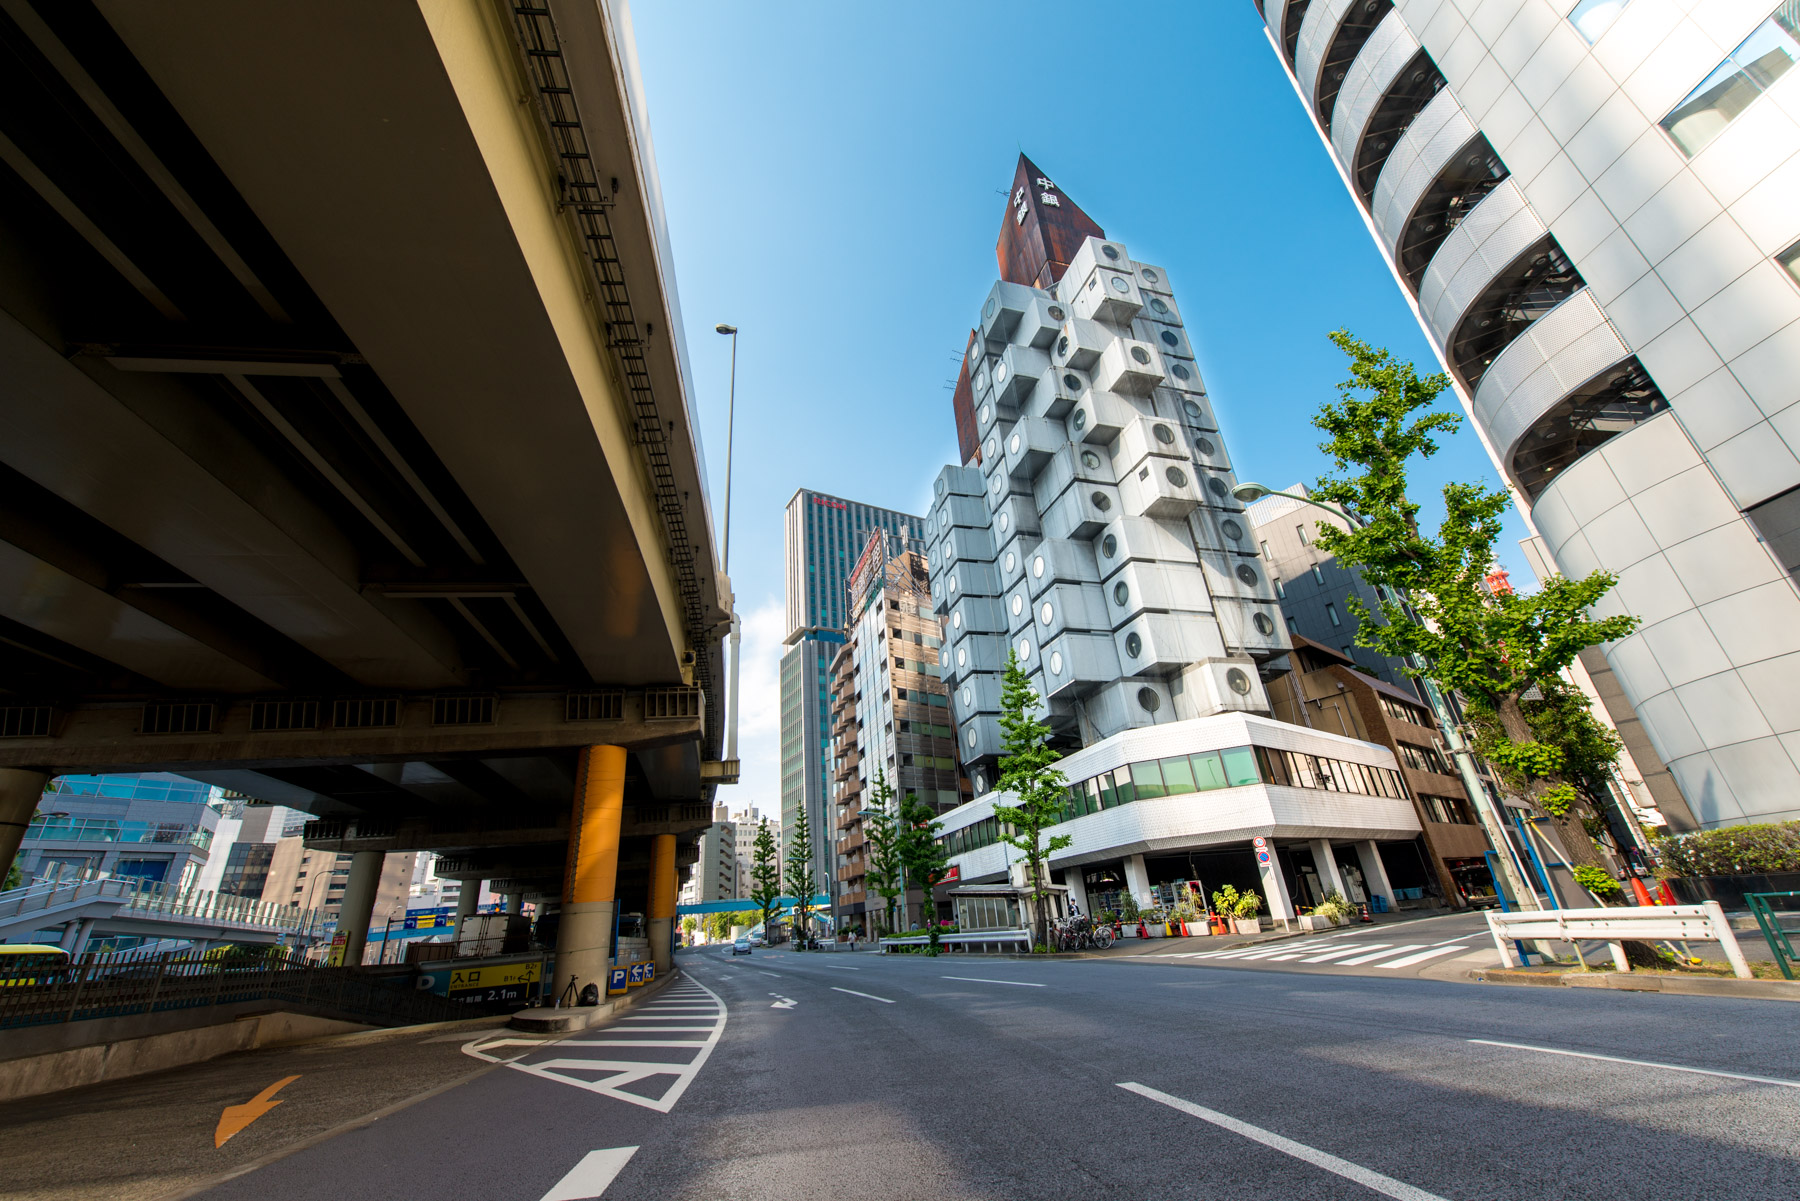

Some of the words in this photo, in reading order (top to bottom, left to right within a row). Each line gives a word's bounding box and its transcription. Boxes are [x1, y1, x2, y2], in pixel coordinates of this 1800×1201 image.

[1036, 177, 1060, 208] 中銀
[813, 497, 847, 511] RICOH
[452, 971, 481, 985] 入口
[613, 970, 625, 984] P
[450, 982, 479, 990] ENTRANCE
[487, 988, 517, 1001] 2.1m
